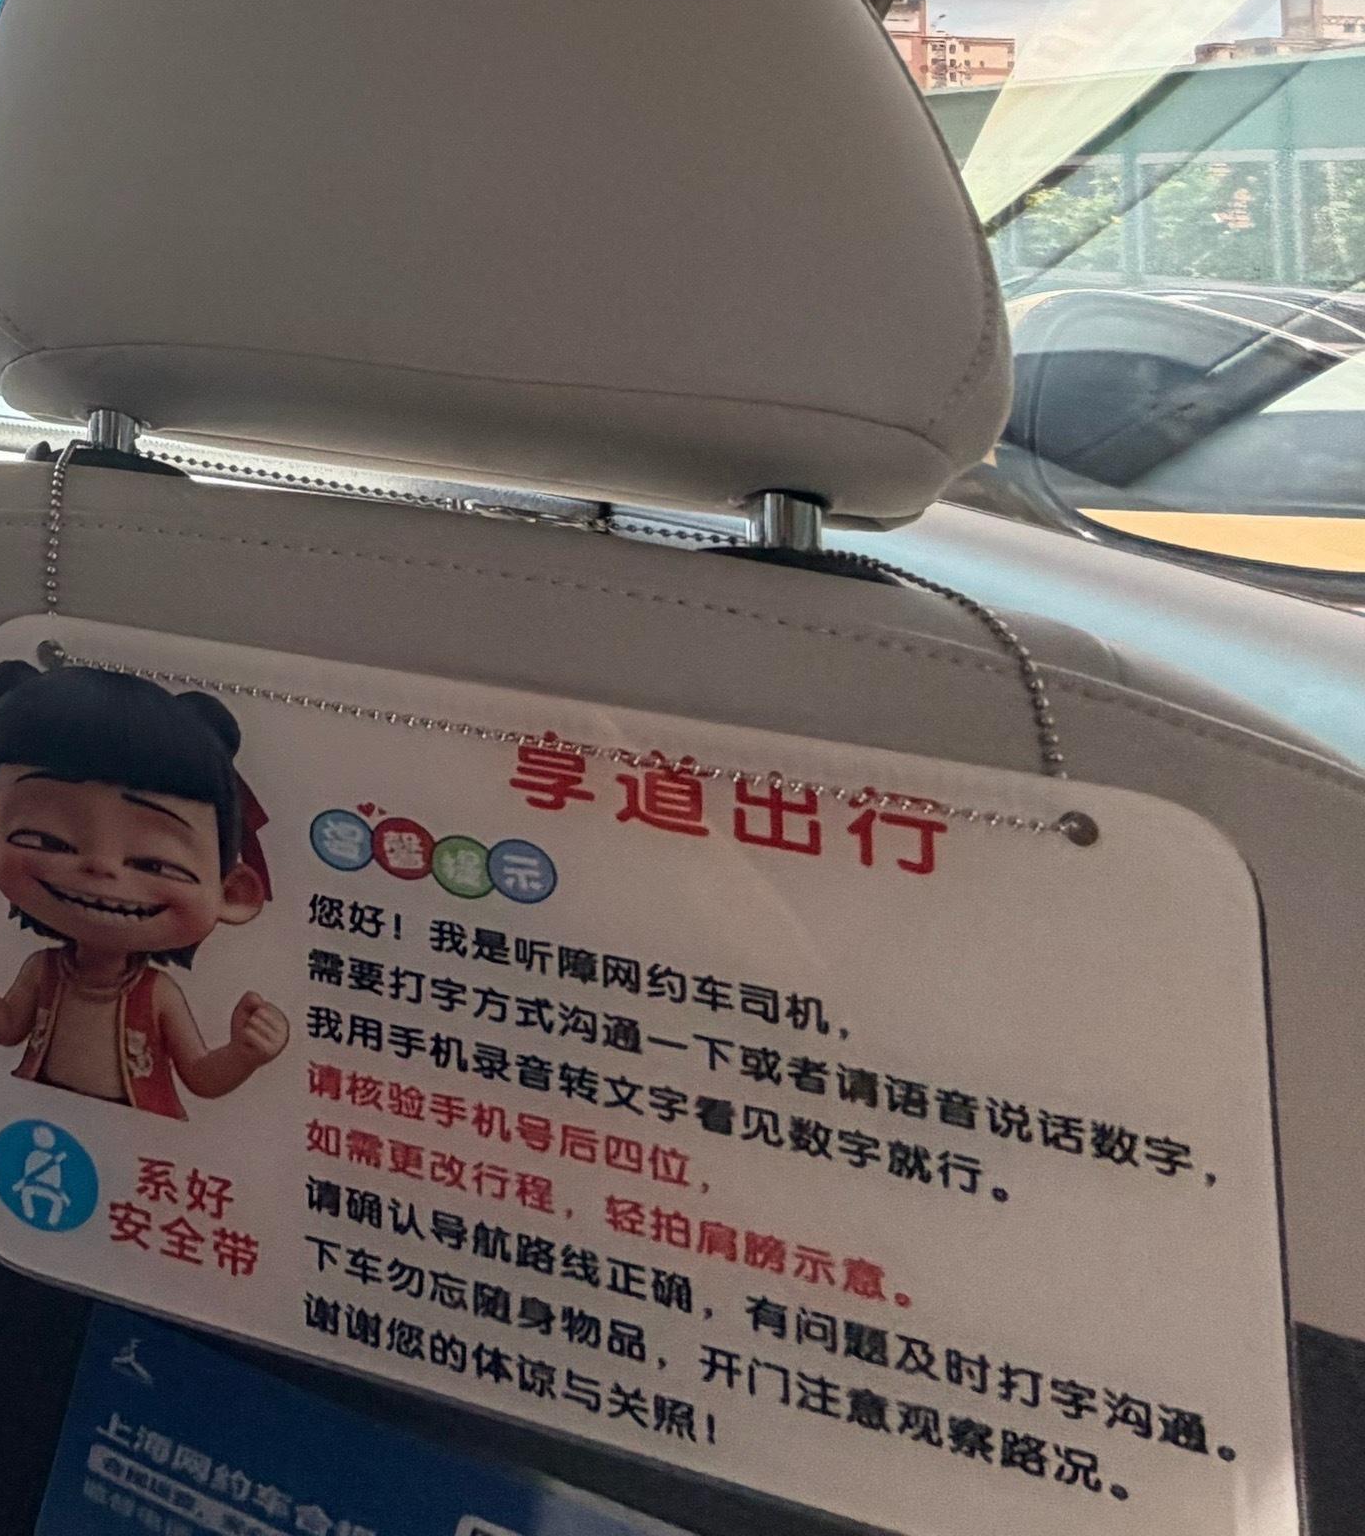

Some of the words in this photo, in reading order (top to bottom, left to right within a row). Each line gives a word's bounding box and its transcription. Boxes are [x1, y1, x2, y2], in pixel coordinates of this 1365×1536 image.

[510, 730, 949, 876] 享道出行
[306, 1005, 1009, 1203] 我用手机录音转文字看见数字就行。
[306, 1060, 712, 1194] 请核验手机号后四位，
[307, 948, 1218, 1189] 需要打字方式沟通一下或者请语音说话数字，
[108, 1201, 260, 1279] 安全带
[136, 1155, 234, 1221] 系好
[305, 1118, 914, 1309] 如需更改行程，轻拍肩膀示意。
[303, 1291, 718, 1445] 谢谢您的体谅与关照！
[305, 1174, 1237, 1463] 请确认导航路线正确，有问题及时打字沟通。
[305, 1234, 1130, 1502] 下车勿忘随身物品，开门注意观察路况。
